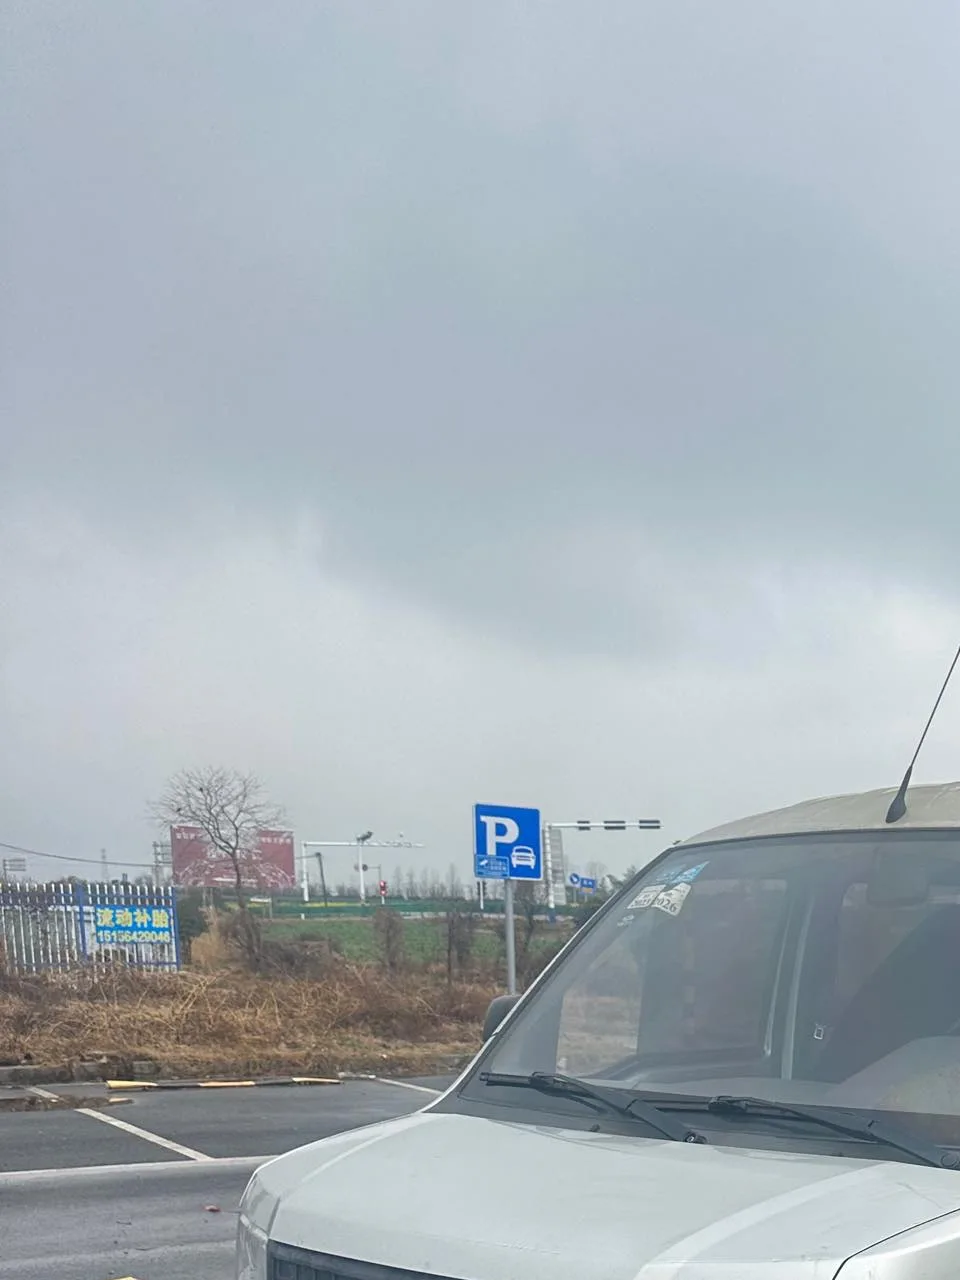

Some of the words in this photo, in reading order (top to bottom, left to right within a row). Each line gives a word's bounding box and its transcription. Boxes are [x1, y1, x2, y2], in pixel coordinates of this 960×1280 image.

[480, 815, 520, 856] P
[96, 908, 169, 928] 流动补胎
